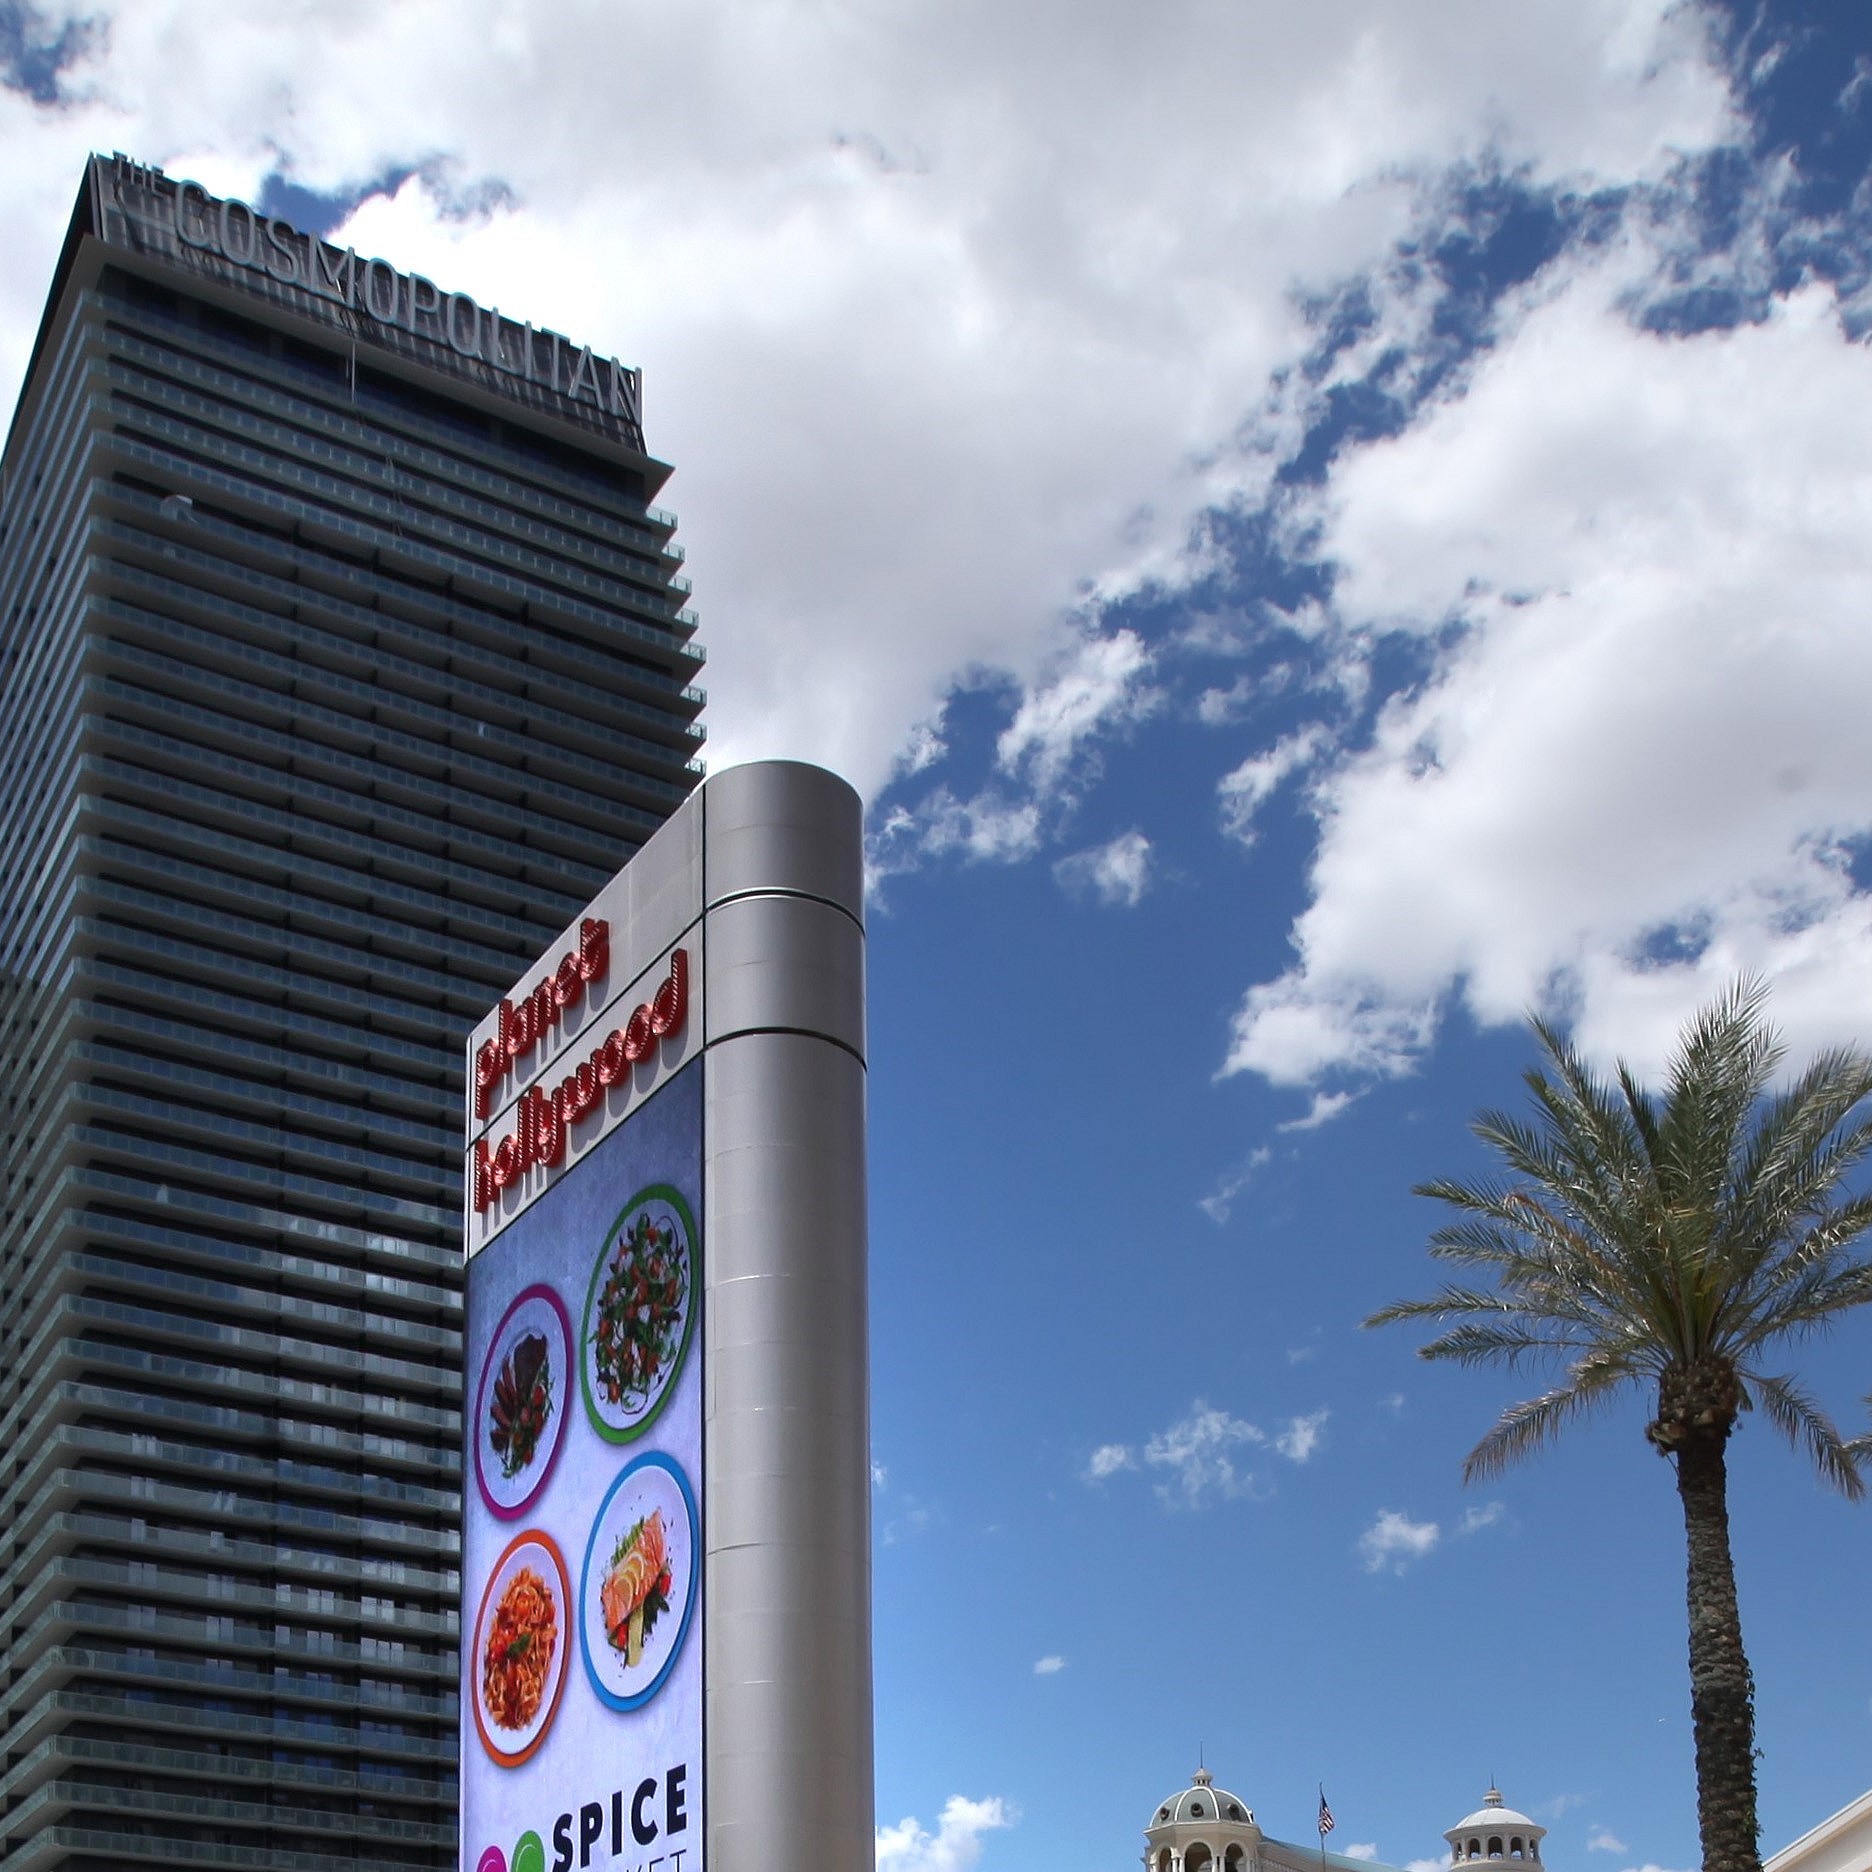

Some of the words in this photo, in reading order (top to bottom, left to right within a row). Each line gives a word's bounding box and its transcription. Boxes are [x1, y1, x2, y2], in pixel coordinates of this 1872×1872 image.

[112, 151, 164, 198] THE
[174, 179, 644, 428] COSMOPOLITAN
[474, 947, 688, 1213] hollywood
[475, 917, 609, 1120] planet
